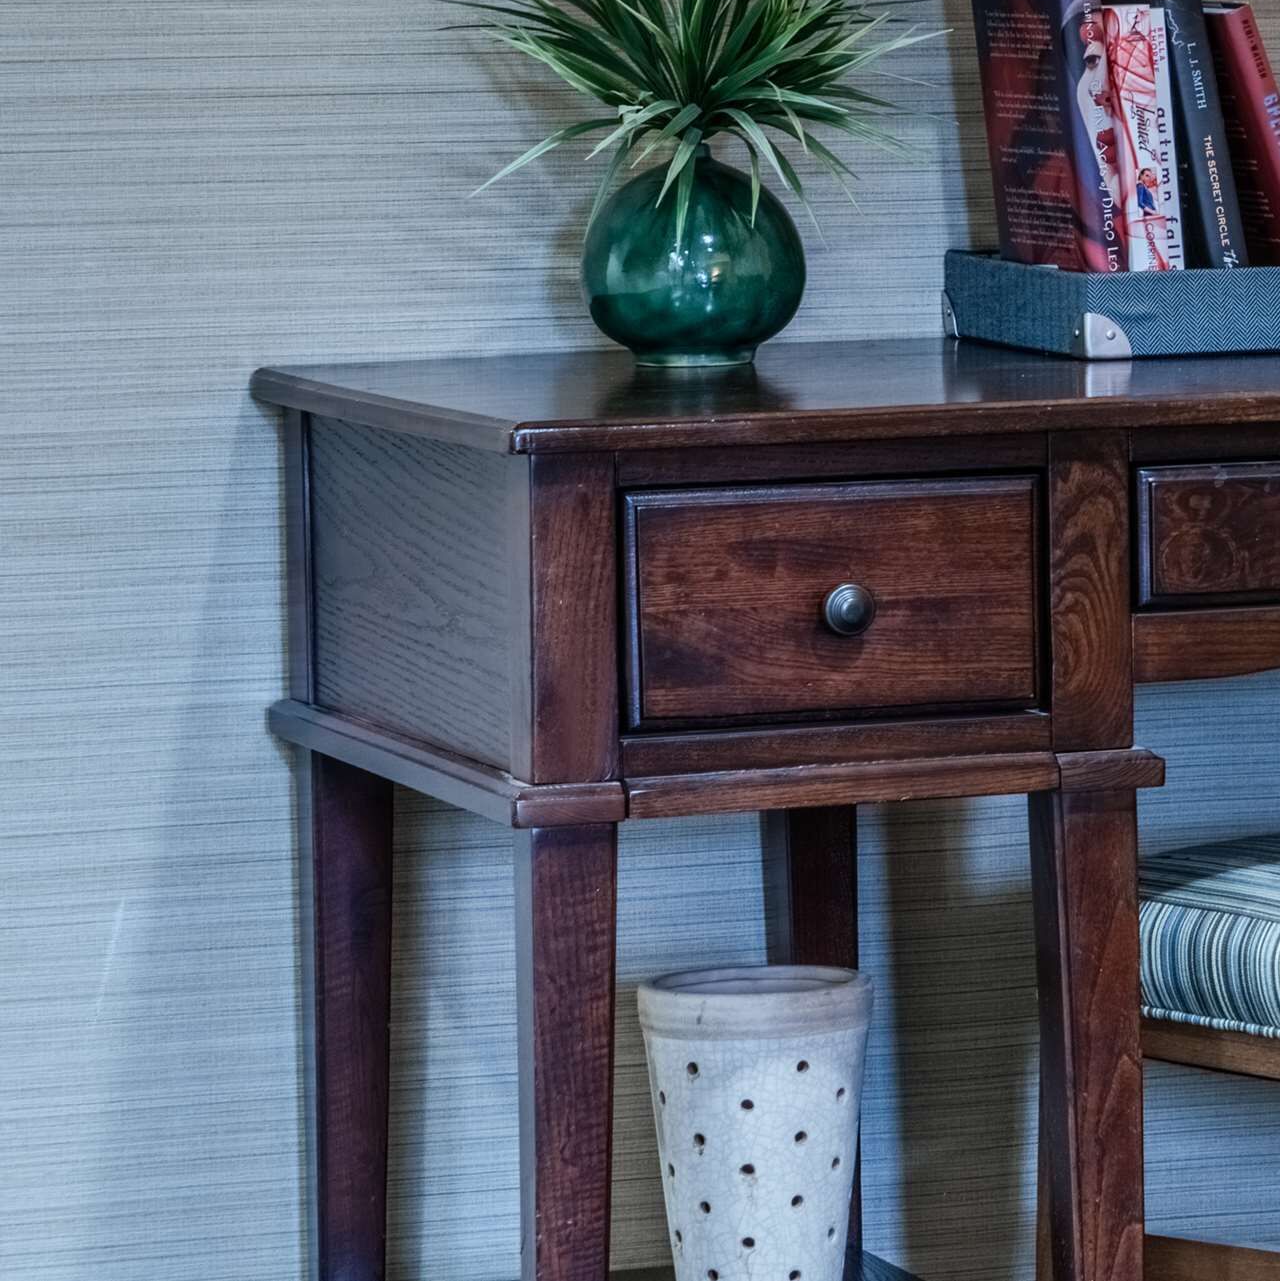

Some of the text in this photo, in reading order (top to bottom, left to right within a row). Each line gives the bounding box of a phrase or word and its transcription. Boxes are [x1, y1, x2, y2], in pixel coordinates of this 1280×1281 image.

[1187, 42, 1196, 55] L.
[1192, 69, 1208, 109] SMITH
[1156, 107, 1172, 202] autumn
[1203, 135, 1215, 158] THE
[1207, 159, 1222, 204] SECRET
[1215, 205, 1230, 248] CIRCLE
